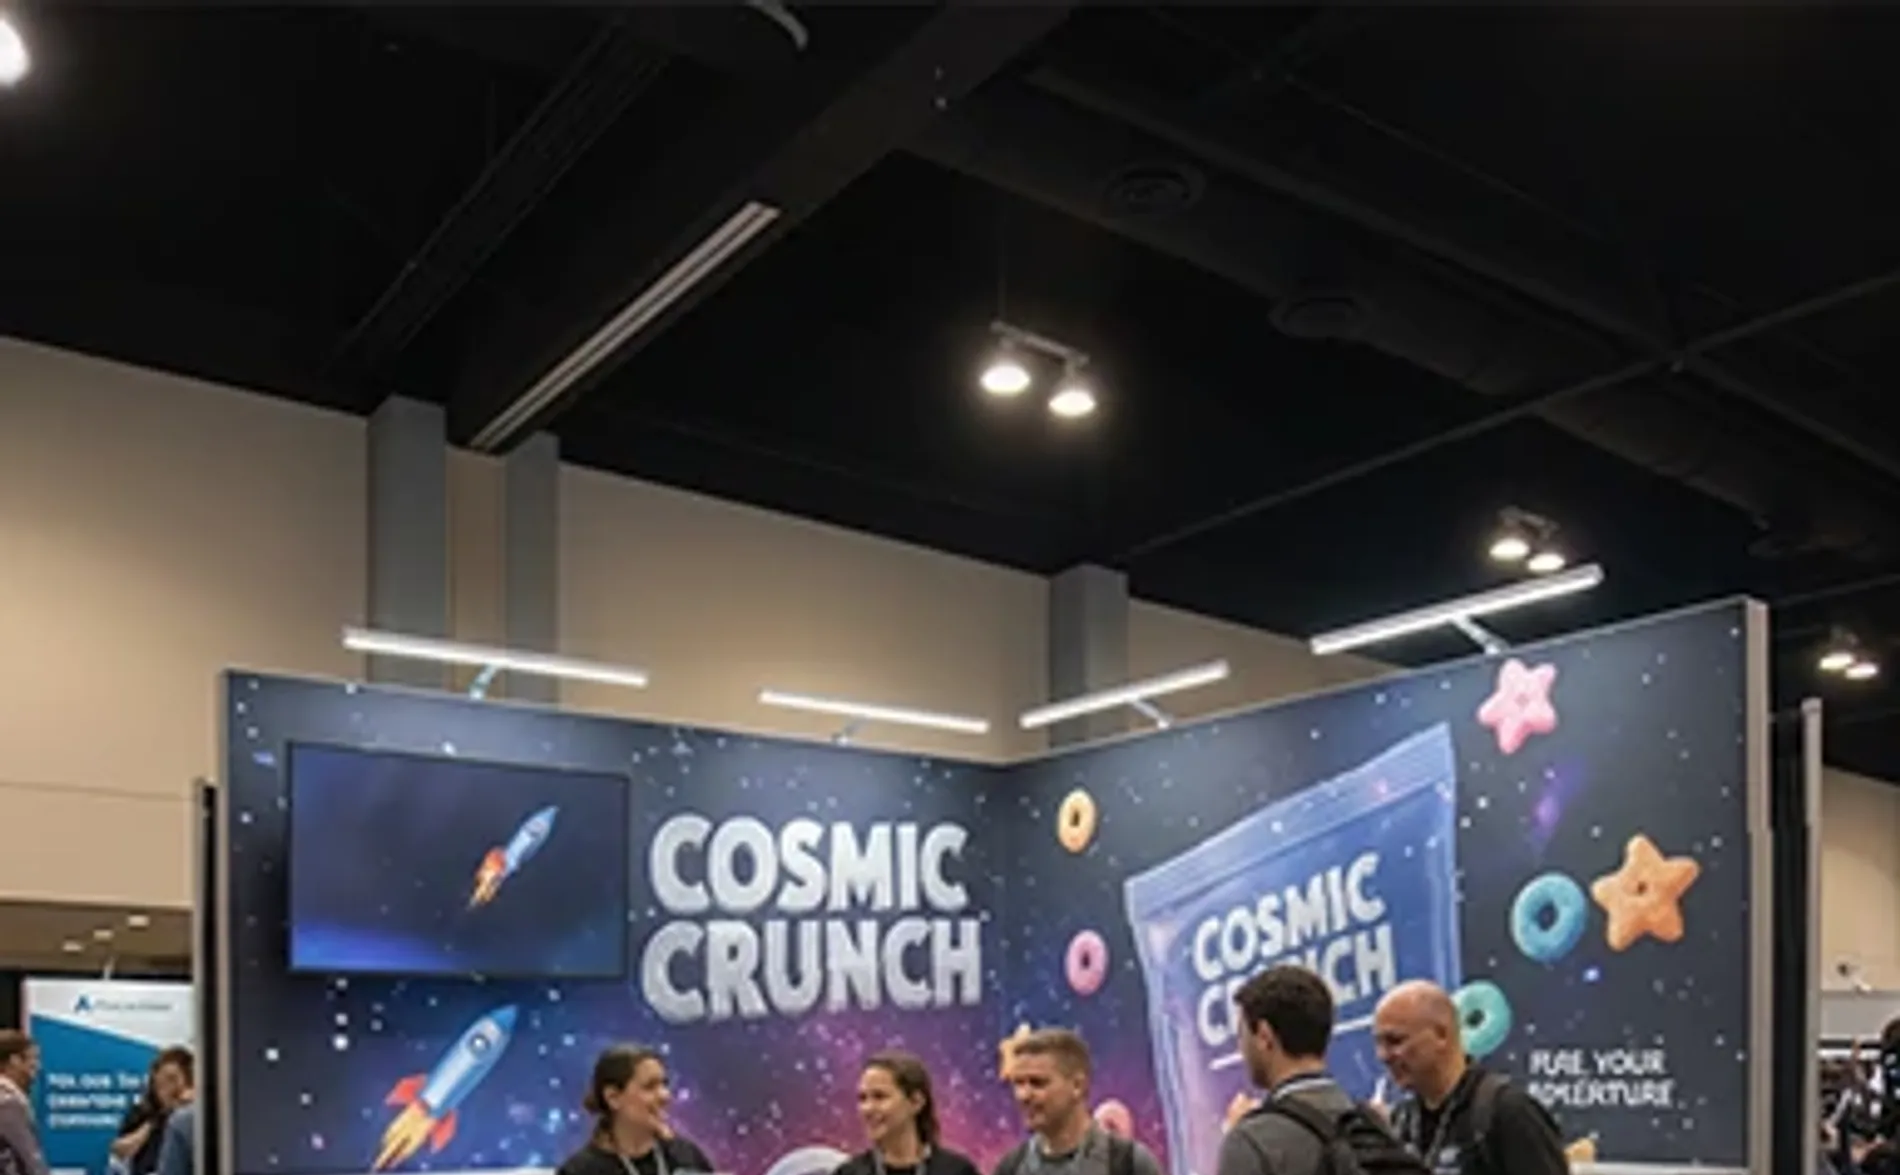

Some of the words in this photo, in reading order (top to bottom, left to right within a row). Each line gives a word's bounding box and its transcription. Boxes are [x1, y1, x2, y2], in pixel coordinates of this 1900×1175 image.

[650, 813, 968, 914] COSMIC
[1193, 852, 1386, 981] COSMIC
[641, 918, 982, 1024] CRUNCH
[1197, 923, 1397, 1045] CCH
